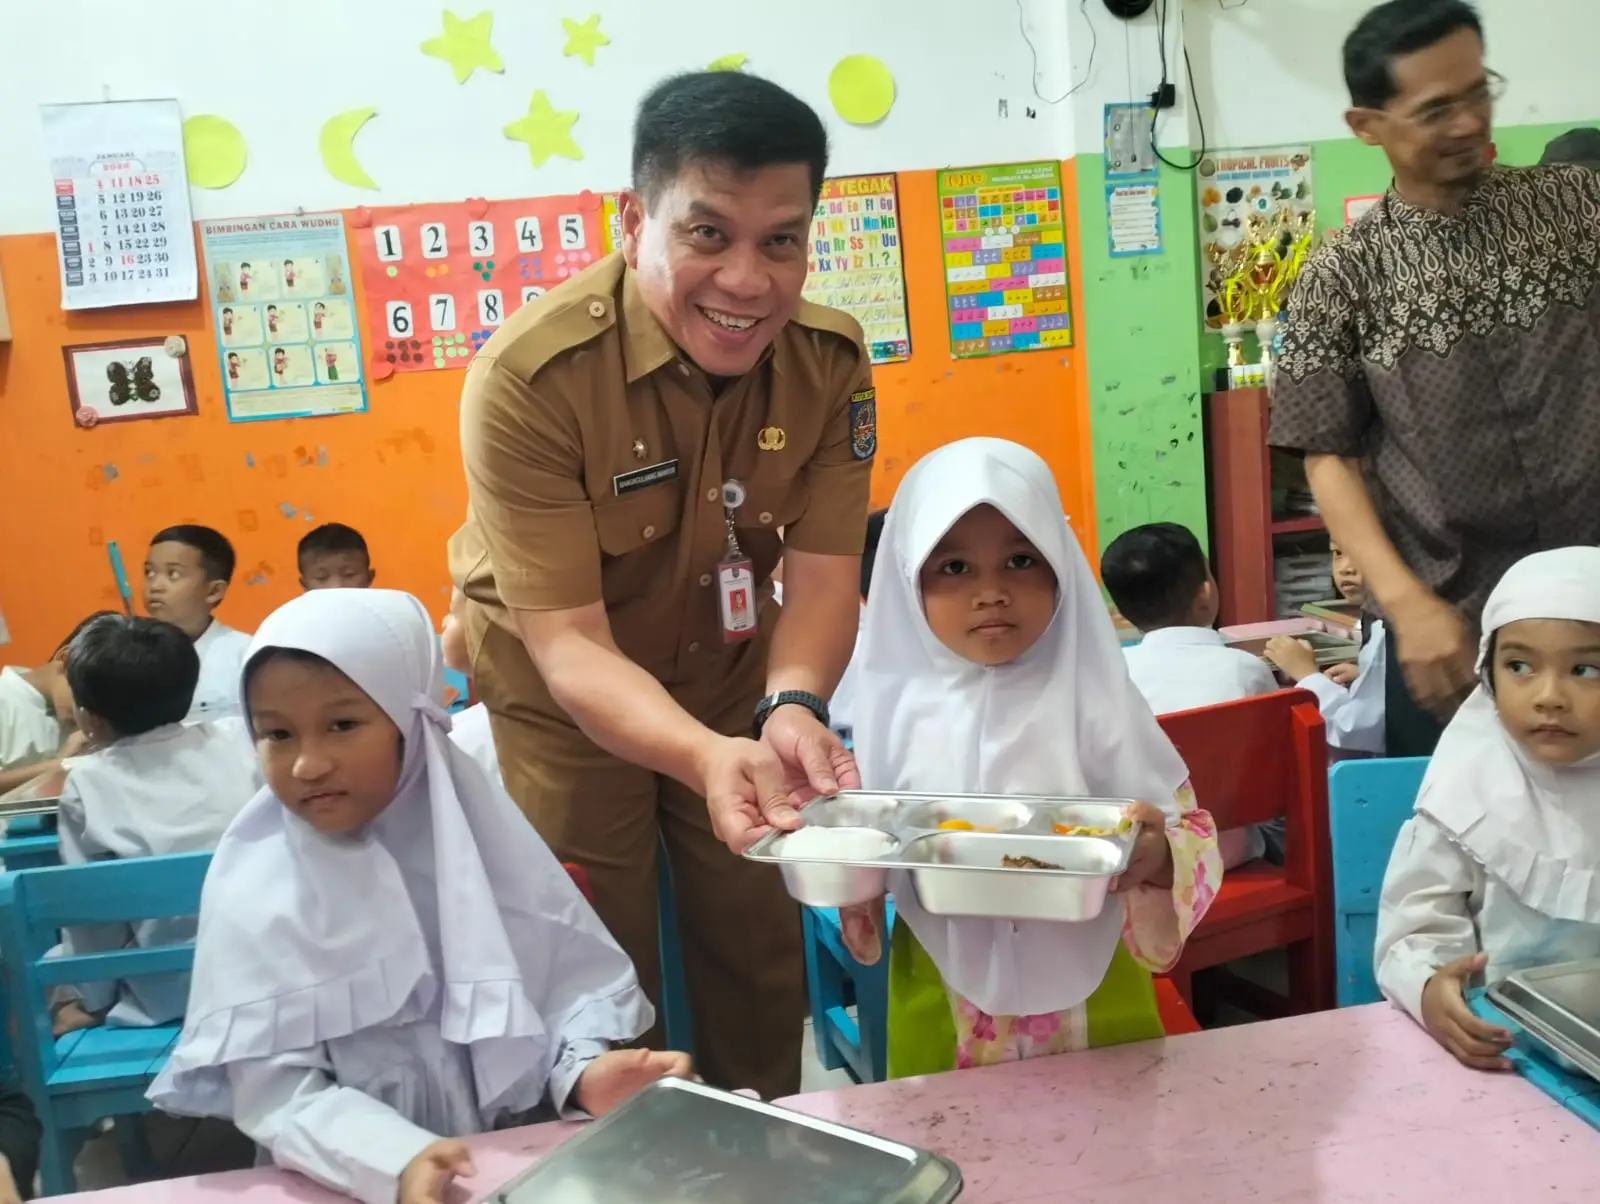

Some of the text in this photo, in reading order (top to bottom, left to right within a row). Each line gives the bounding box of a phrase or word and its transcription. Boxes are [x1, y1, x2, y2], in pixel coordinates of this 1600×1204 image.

[1217, 155, 1289, 171] TROPICAL FRUITS
[146, 174, 160, 185] 25
[836, 177, 891, 195] TEGAK
[113, 193, 126, 204] 12
[131, 191, 144, 202] 19
[147, 190, 162, 201] 26
[100, 205, 163, 220] 6 13 20 27
[101, 221, 166, 236] 7 14 21 28
[205, 218, 339, 235] BIMBINGAN CARA WUDHU
[103, 241, 111, 251] 8
[119, 239, 132, 250] 15
[135, 238, 150, 249] 22
[153, 237, 168, 248] 29
[382, 218, 579, 257] 1 2 3 4 5
[850, 235, 863, 250] Ss
[882, 233, 896, 247] Uu
[88, 257, 96, 268] 2
[105, 255, 113, 266] 9
[122, 255, 135, 266] 16
[137, 253, 152, 265] 23
[154, 252, 169, 263] 30
[818, 258, 831, 272] Xx
[89, 272, 97, 283] 3
[104, 271, 118, 282] 10
[122, 270, 135, 281] 17
[138, 269, 152, 280] 24
[156, 267, 169, 278] 31
[393, 306, 409, 333] 6
[435, 298, 448, 326] 7
[484, 294, 498, 321] 8
